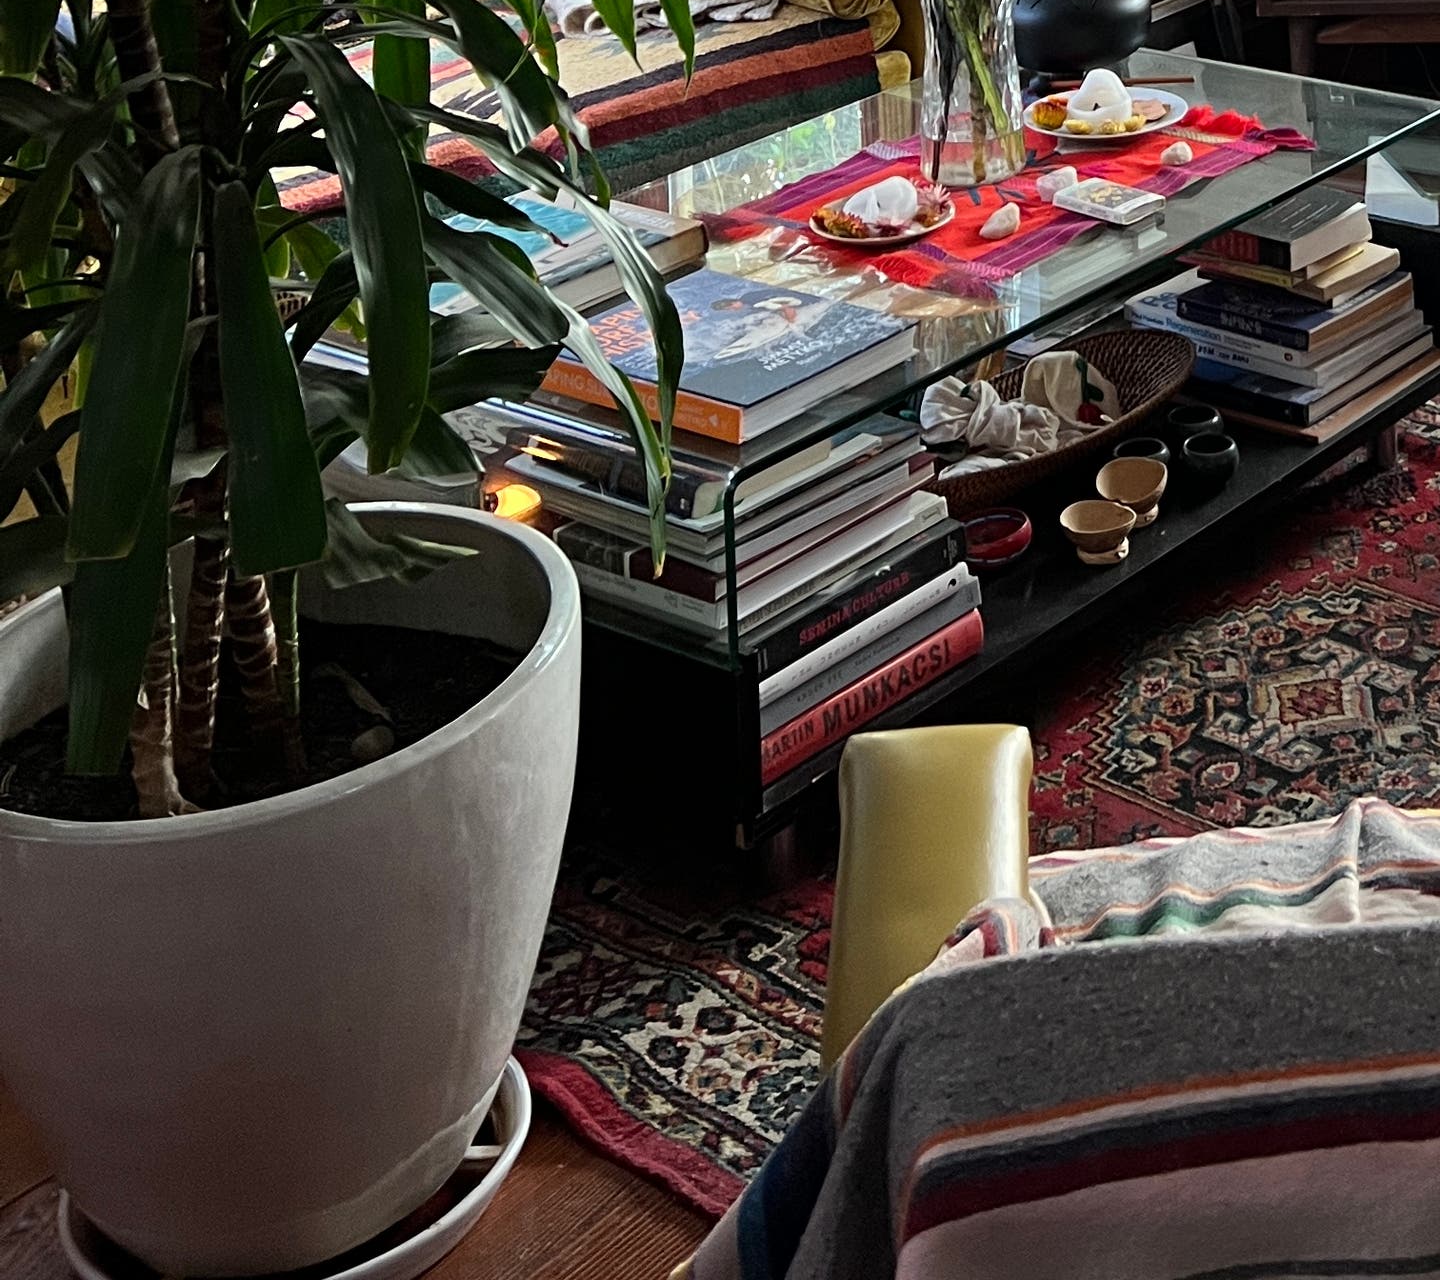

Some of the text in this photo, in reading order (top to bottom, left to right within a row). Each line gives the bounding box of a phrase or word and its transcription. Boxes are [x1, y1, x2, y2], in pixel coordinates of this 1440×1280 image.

[1165, 317, 1222, 343] Regeneration
[799, 606, 851, 646] SEMINA
[822, 639, 949, 740] MUNKACSI
